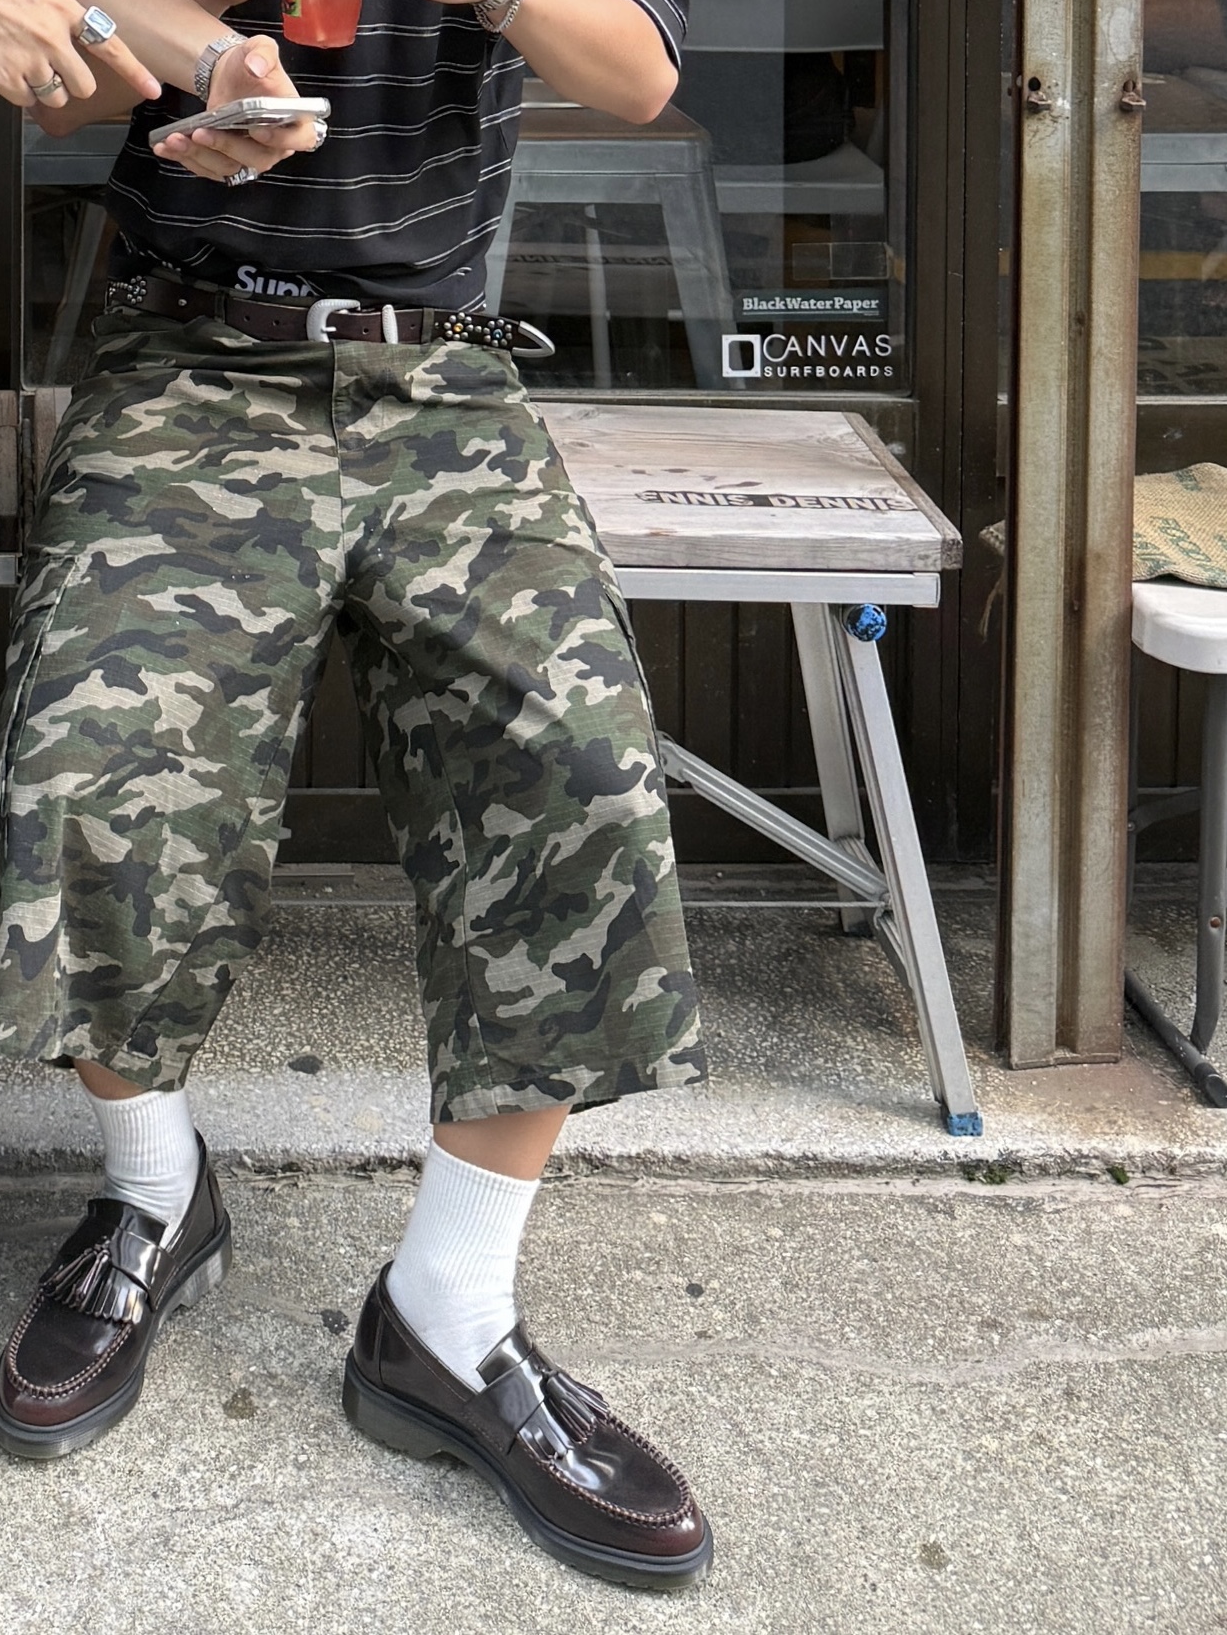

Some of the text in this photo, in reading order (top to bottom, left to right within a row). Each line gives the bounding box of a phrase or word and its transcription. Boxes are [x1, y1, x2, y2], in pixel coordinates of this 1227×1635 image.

[762, 333, 892, 362] CANVAS
[763, 365, 894, 378] SURFBOARDS
[768, 495, 916, 511] DENNIS
